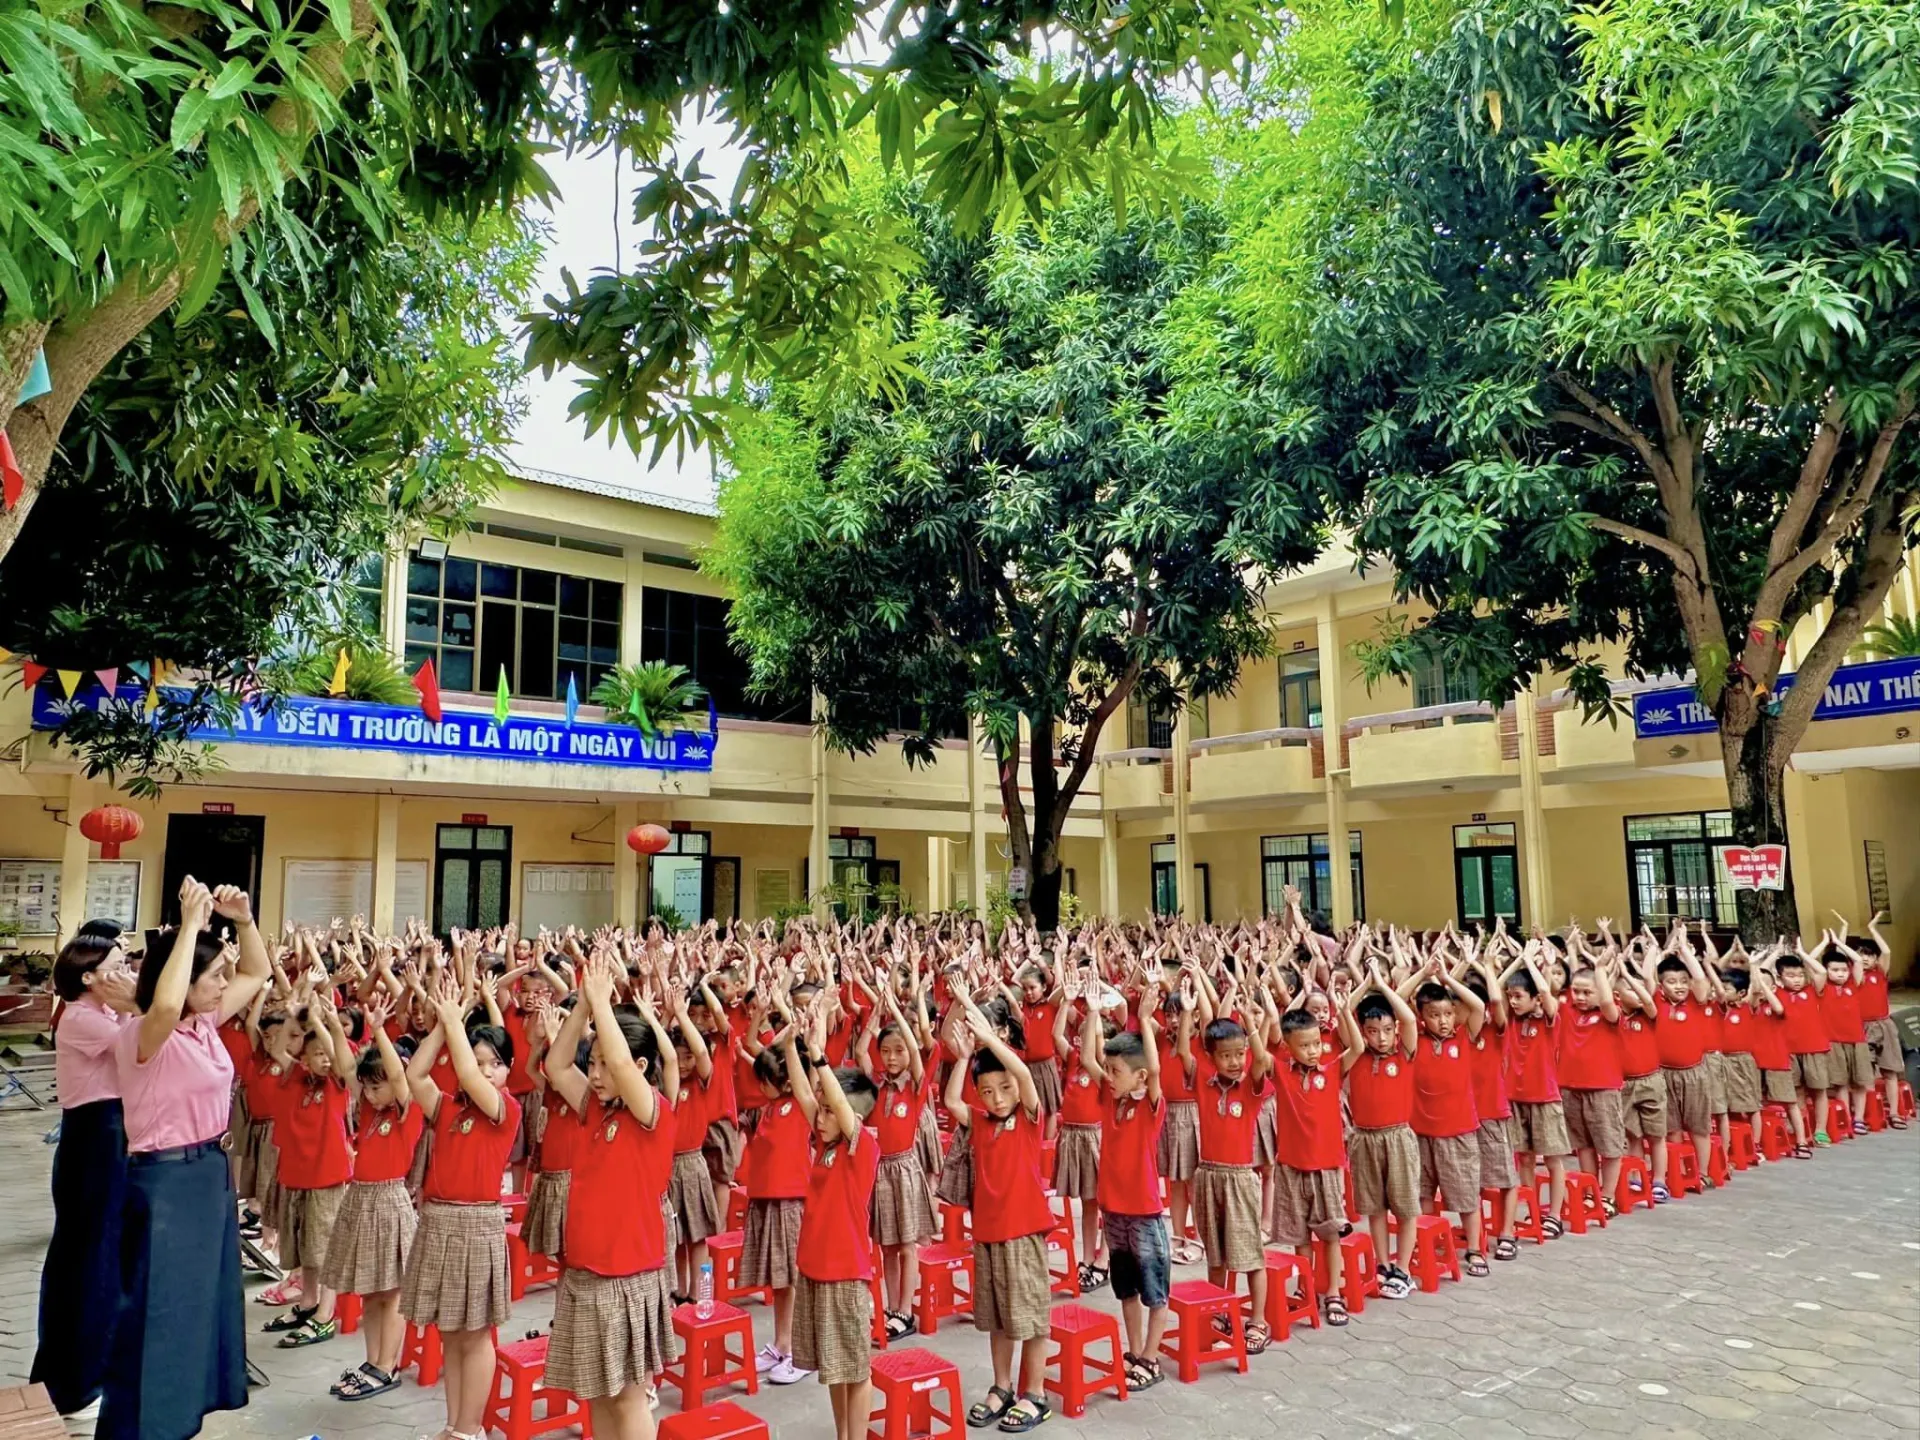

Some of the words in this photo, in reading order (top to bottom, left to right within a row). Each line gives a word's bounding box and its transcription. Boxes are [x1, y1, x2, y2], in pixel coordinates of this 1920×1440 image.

[1825, 681, 1871, 707] NAY
[277, 704, 339, 737] ĐẾN
[349, 714, 460, 746] TRƯỜNG
[469, 722, 501, 748] LÀ
[509, 726, 562, 756] MỘT
[570, 732, 633, 758] NGÀY
[641, 738, 676, 760] VUI
